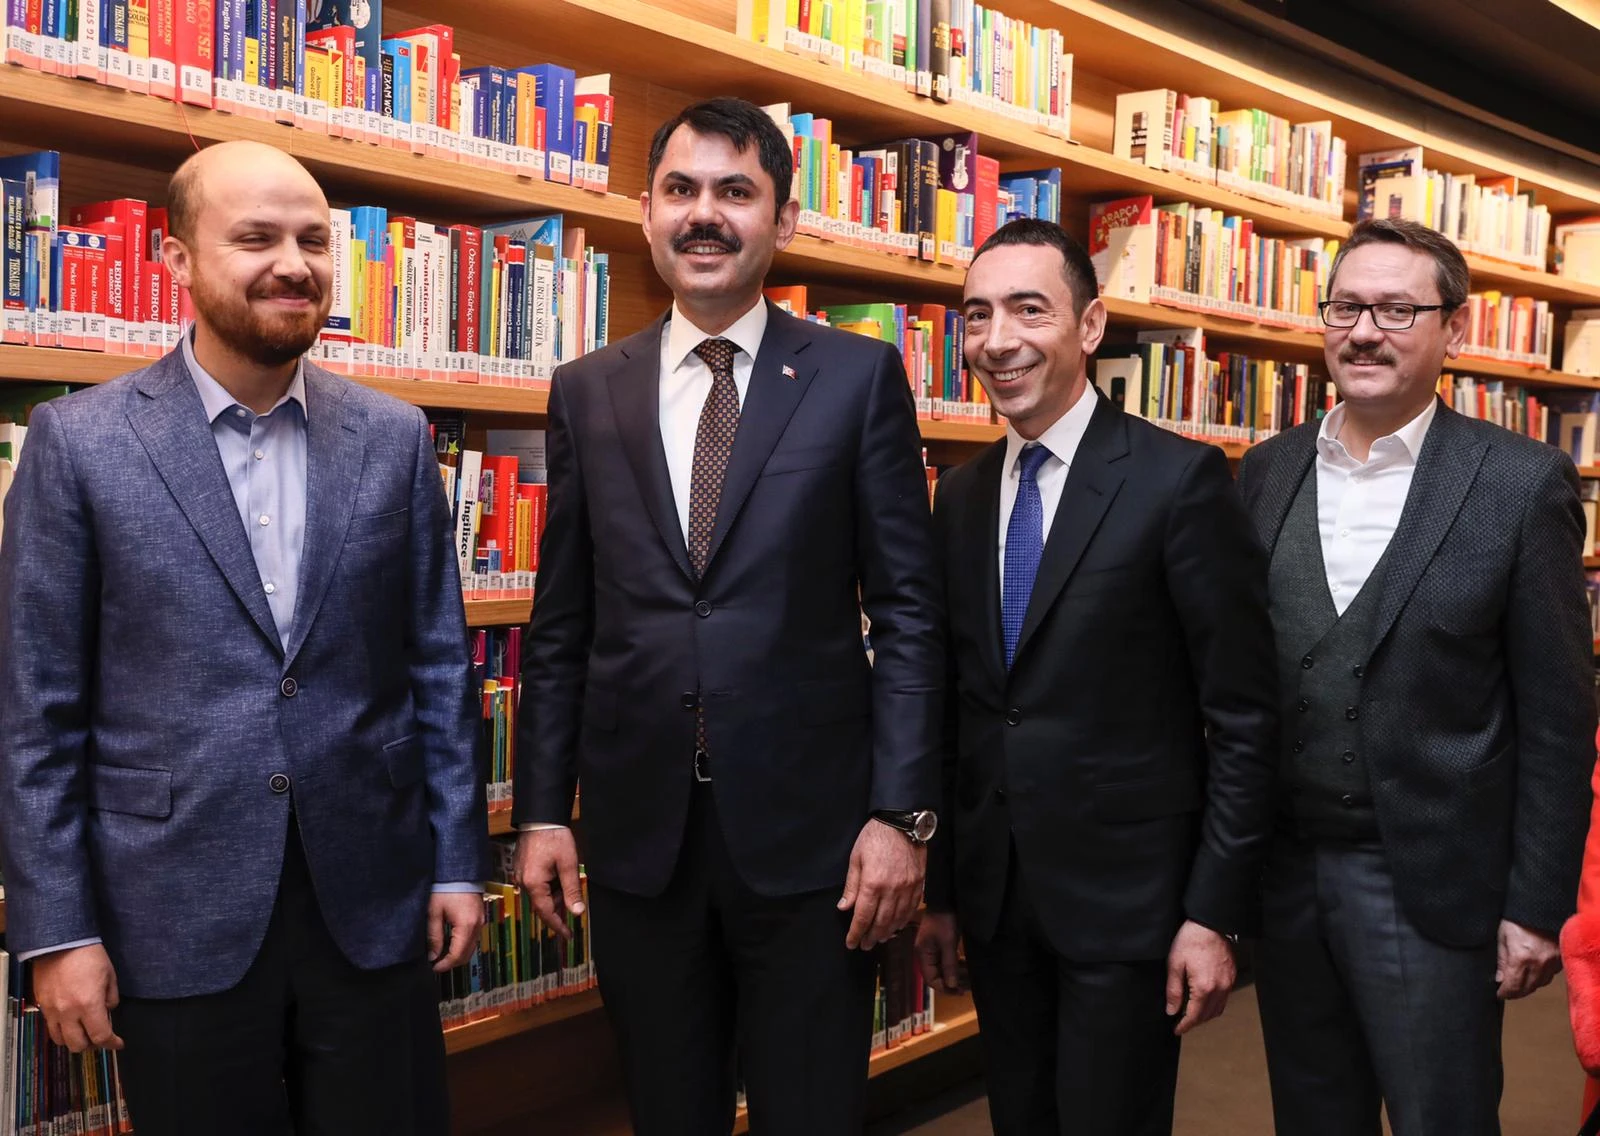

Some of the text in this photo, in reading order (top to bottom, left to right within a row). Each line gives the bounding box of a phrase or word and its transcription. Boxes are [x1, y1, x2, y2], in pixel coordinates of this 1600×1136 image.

[115, 4, 124, 42] THESAURUS
[222, 1, 230, 58] English Idioms
[1102, 204, 1139, 225] ARAPÇA
[9, 258, 20, 297] THESAURUS
[114, 260, 122, 314] REDHOUSE
[468, 248, 476, 286] Özbekçe
[150, 273, 160, 321] REDHOU
[170, 276, 178, 325] REDHOU
[536, 276, 545, 348] KURGUSAL SÖZLÜK
[460, 500, 475, 558] İngilizce
